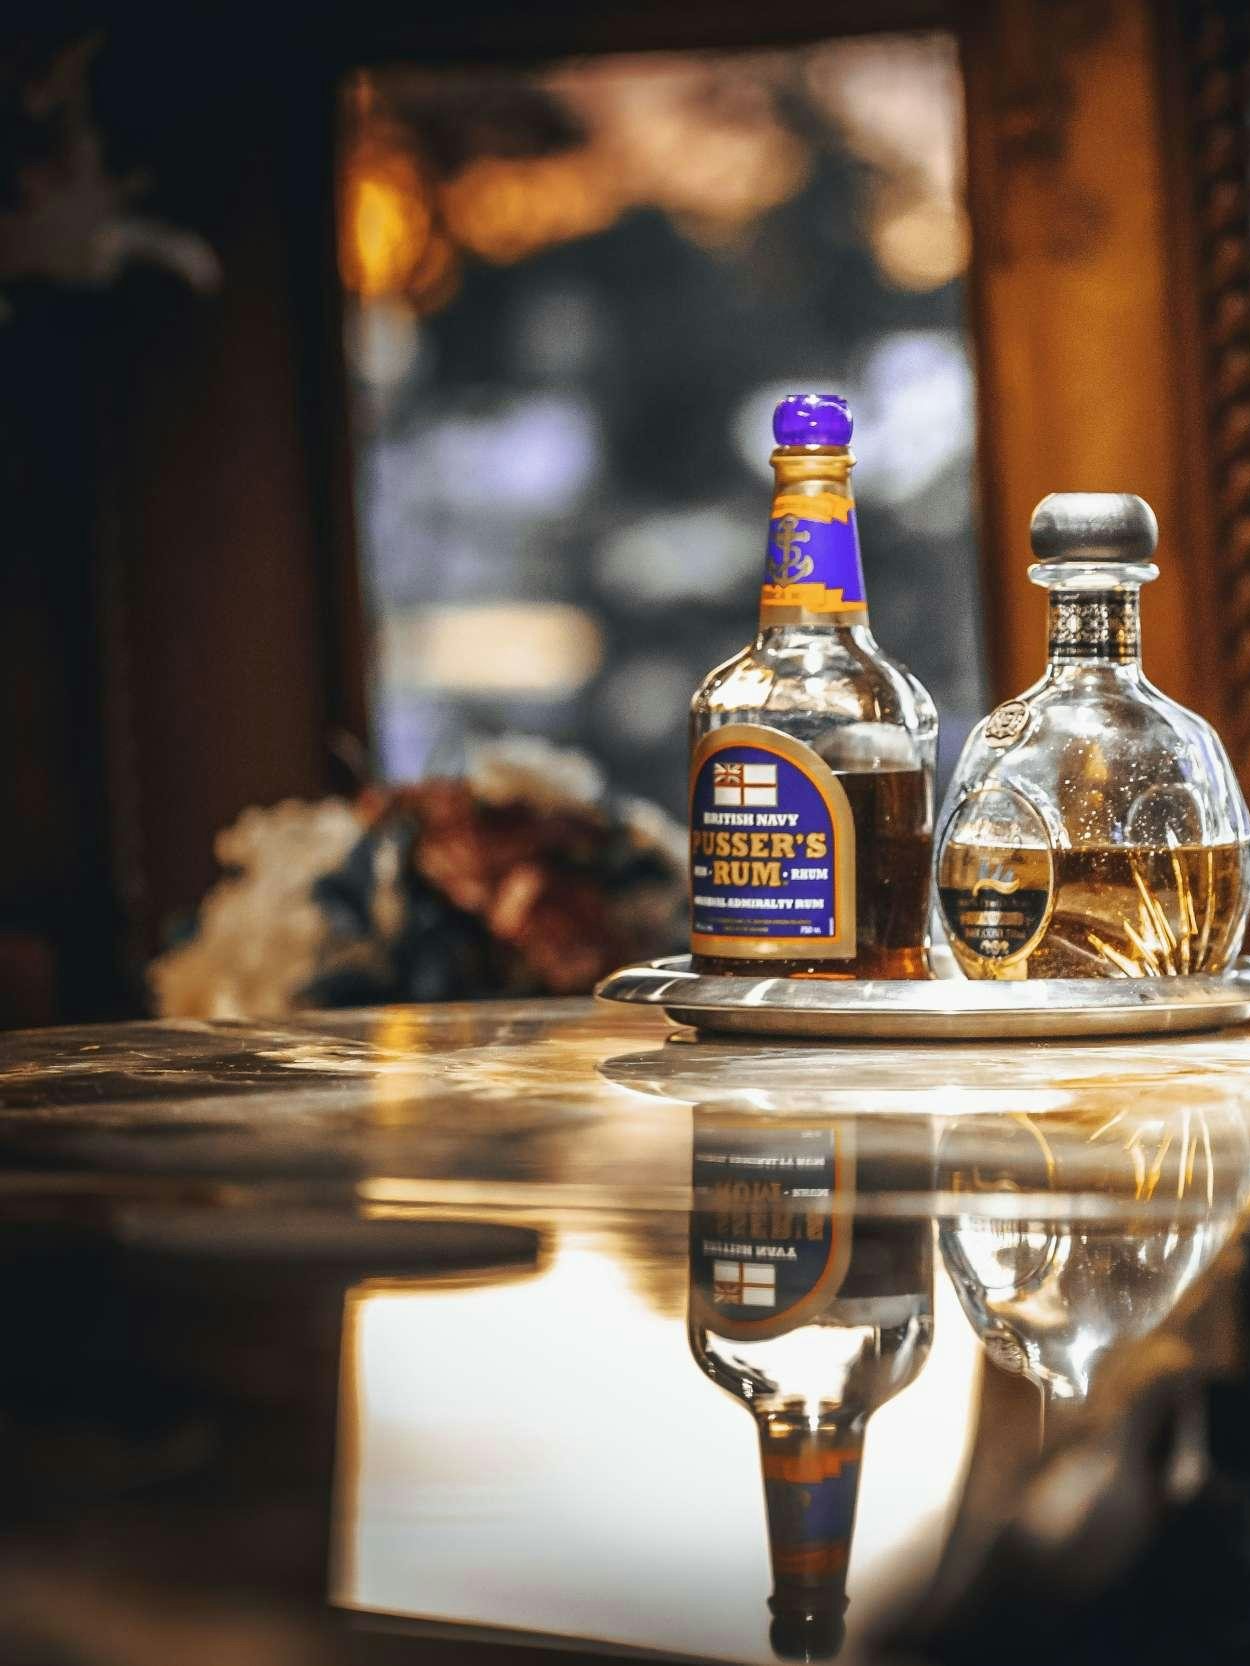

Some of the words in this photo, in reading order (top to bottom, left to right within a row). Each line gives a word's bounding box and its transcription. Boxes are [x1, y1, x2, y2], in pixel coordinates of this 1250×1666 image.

[703, 811, 754, 826] BRITISH
[756, 813, 800, 827] NAVY
[713, 860, 782, 887] RUM
[790, 868, 829, 881] RHUM
[795, 899, 825, 910] RUM
